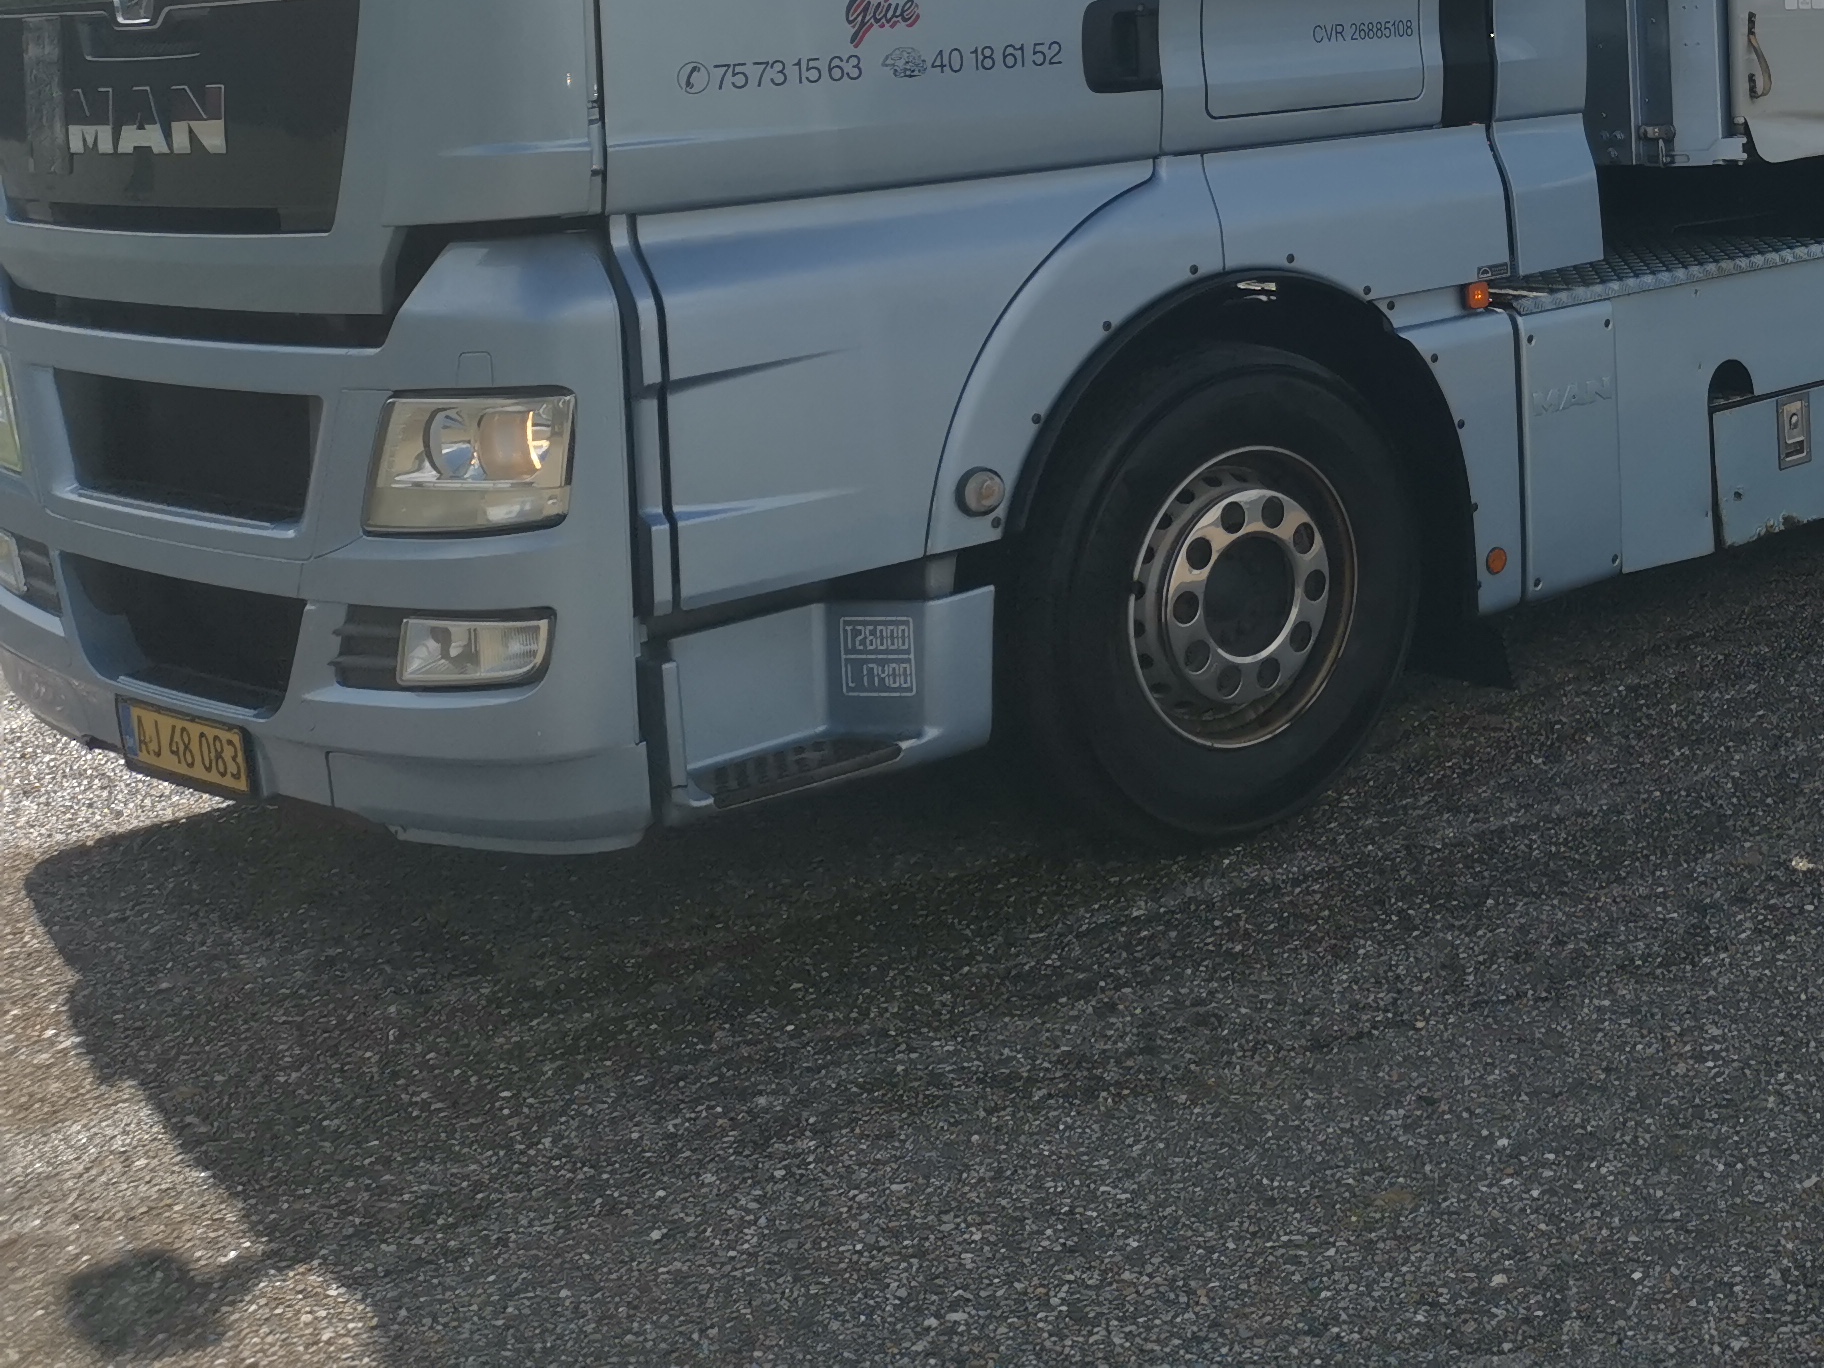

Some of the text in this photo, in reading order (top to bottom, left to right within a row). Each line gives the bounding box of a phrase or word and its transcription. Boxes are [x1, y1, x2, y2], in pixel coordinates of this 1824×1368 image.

[1312, 19, 1414, 43] CVR 26885108
[68, 84, 227, 154] MAN
[1532, 376, 1613, 417] MAN
[136, 715, 242, 780] AJ 48 083
